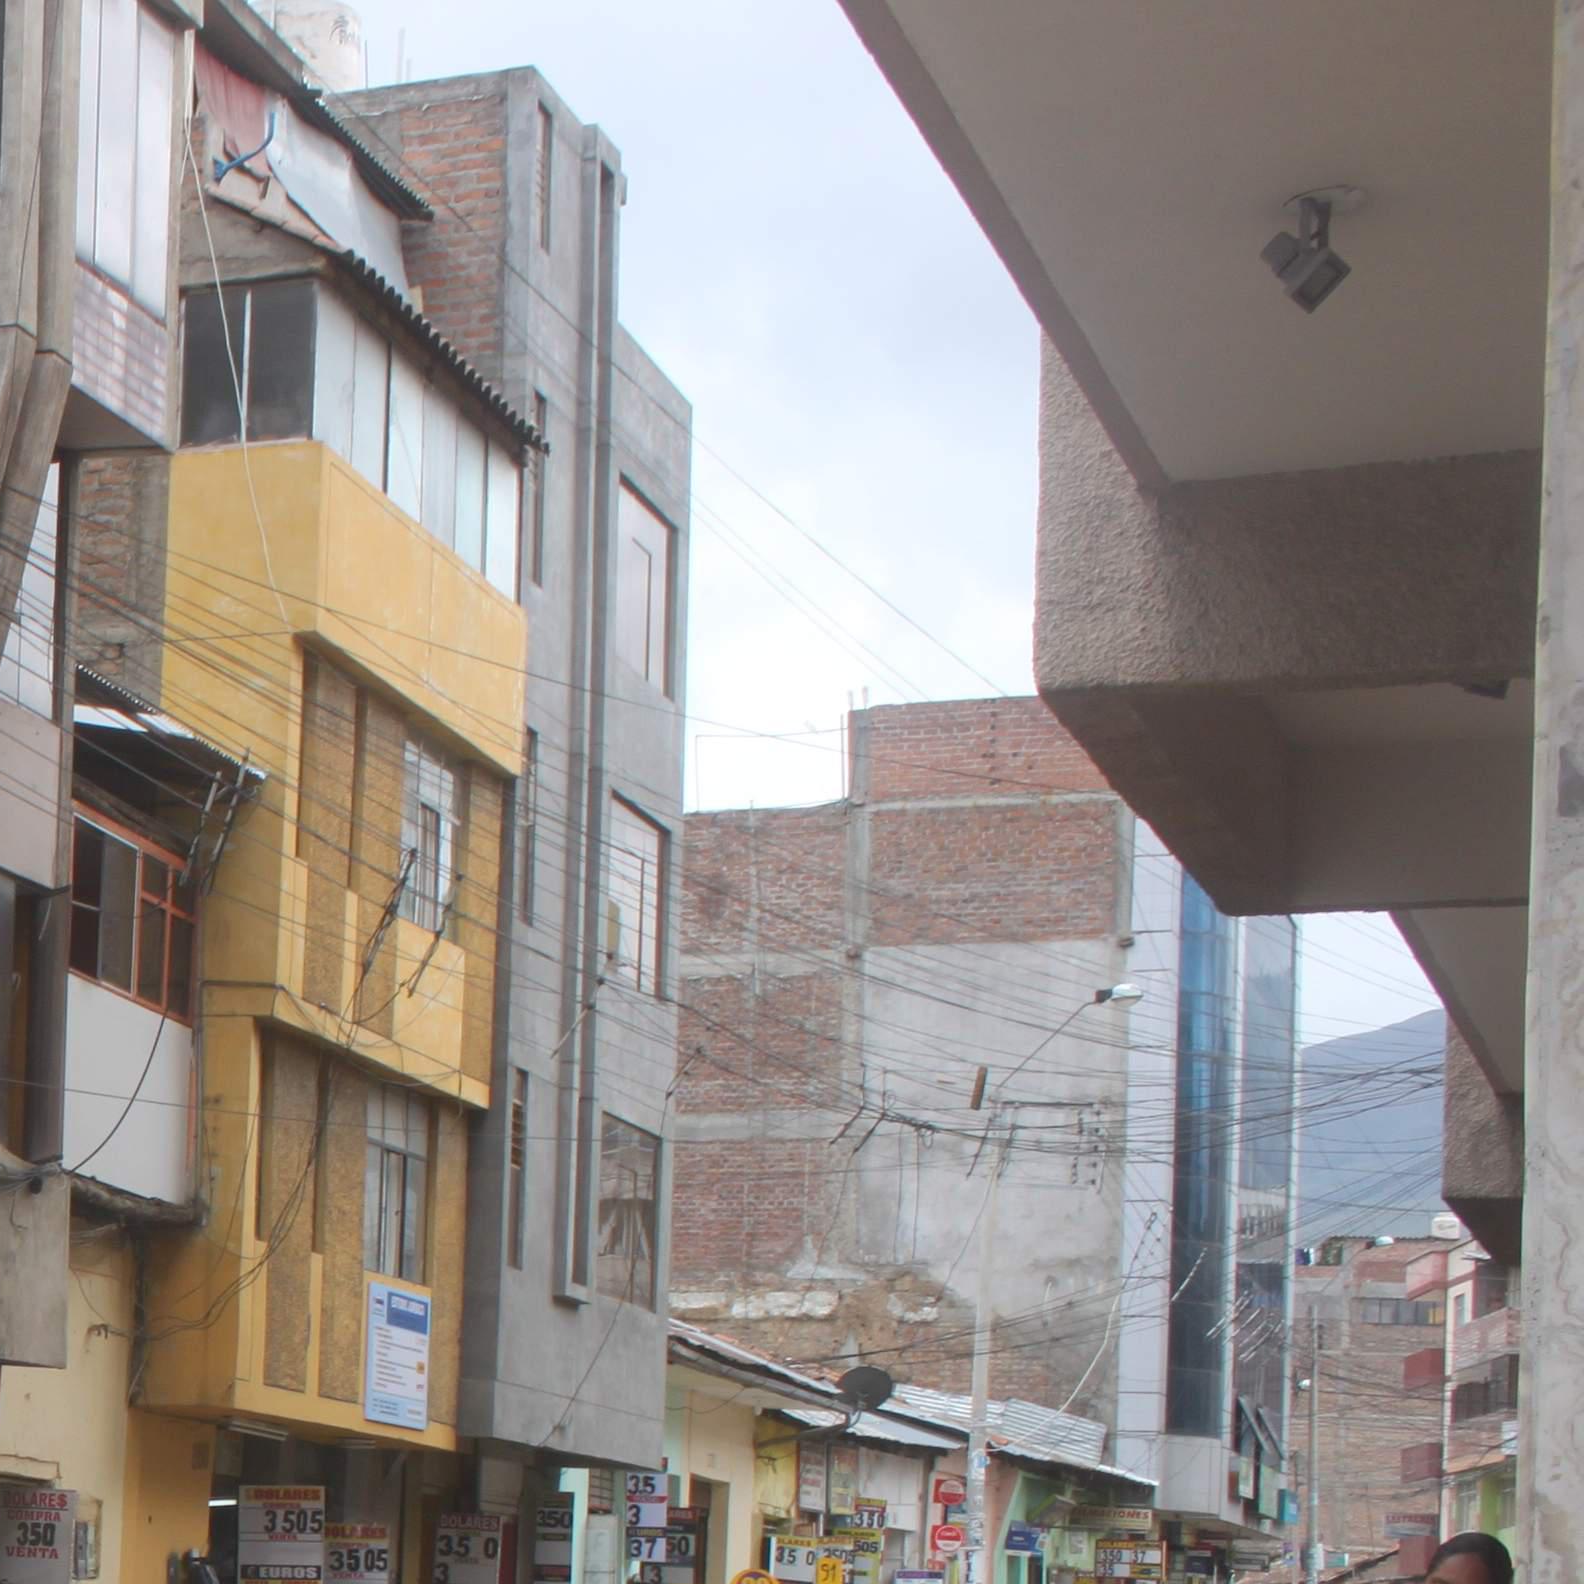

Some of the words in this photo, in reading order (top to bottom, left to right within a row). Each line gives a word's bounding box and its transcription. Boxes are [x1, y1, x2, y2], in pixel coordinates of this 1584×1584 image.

[7, 1509, 62, 1522] COMPRA
[16, 1521, 56, 1547] 350
[5, 1546, 60, 1559] VENTA
